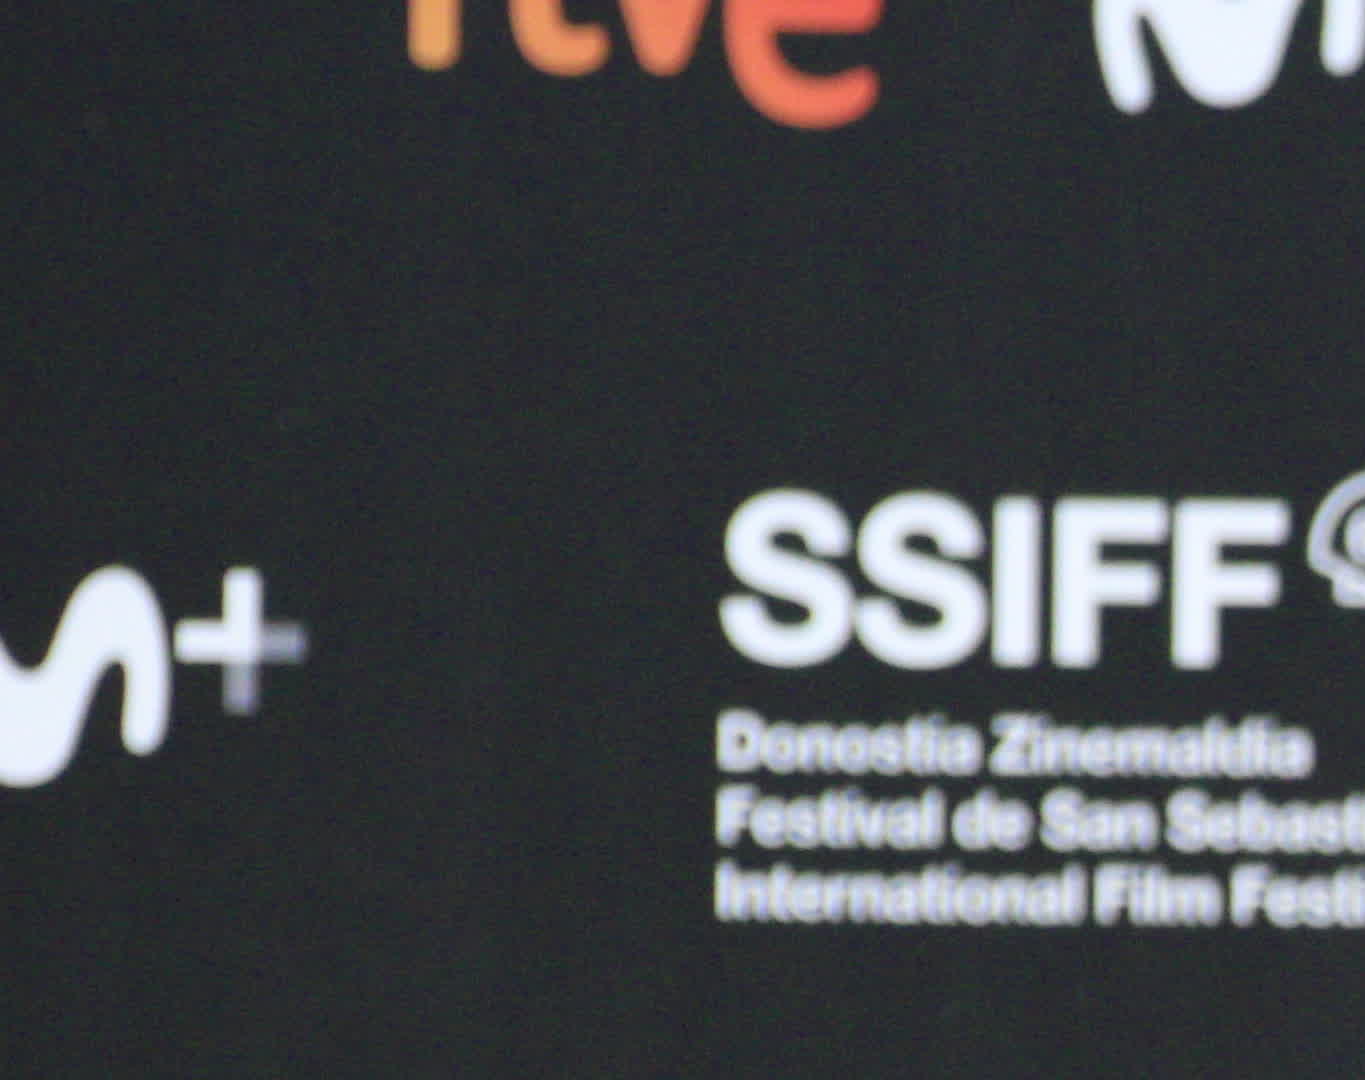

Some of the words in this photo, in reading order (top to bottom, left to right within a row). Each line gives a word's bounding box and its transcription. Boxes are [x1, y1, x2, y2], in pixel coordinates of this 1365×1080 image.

[719, 488, 1291, 670] SSIFF
[716, 709, 984, 776] Donostia
[988, 713, 1316, 779] Zinemaldia
[715, 784, 946, 850] Festival
[951, 788, 1034, 851] de
[1040, 787, 1159, 852] San
[714, 859, 1088, 925] International
[1093, 862, 1224, 926] Film
